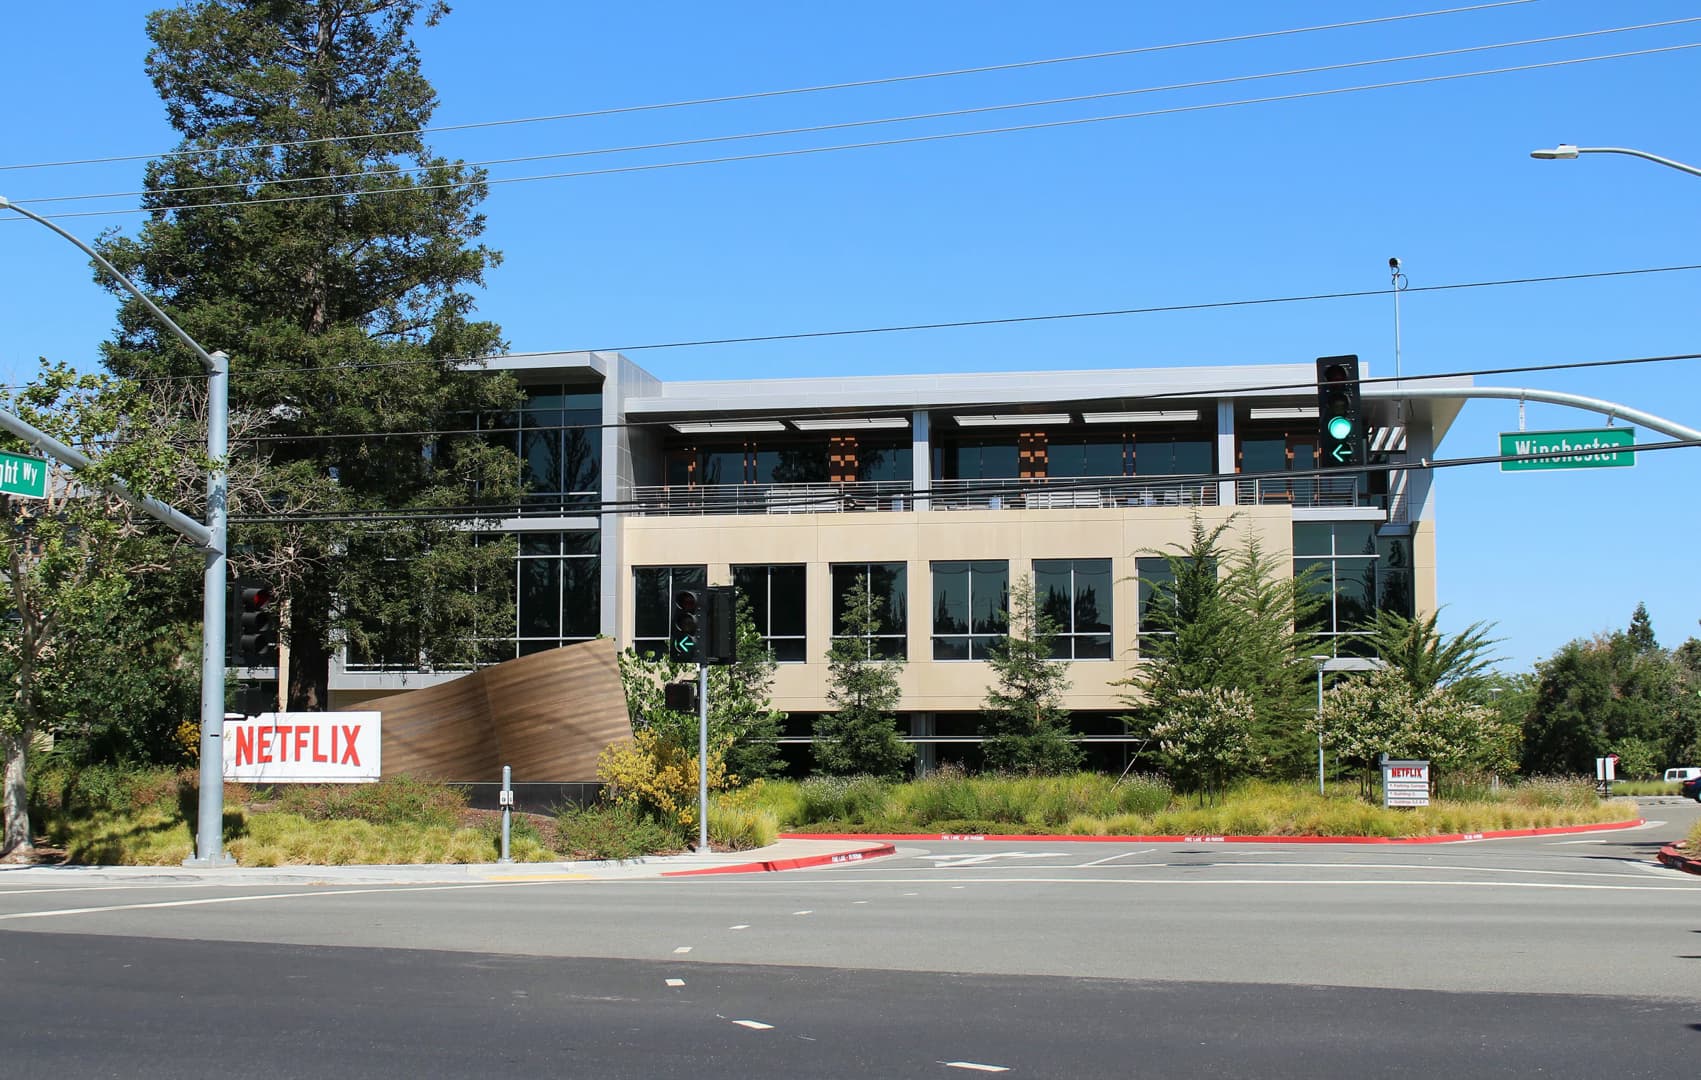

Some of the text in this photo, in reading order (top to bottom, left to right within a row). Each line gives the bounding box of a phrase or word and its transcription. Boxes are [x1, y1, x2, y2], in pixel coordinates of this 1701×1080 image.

[1515, 438, 1620, 463] Winchester
[23, 462, 38, 487] Wy
[235, 725, 361, 767] NETFLIX
[1392, 767, 1422, 778] NETFLIX
